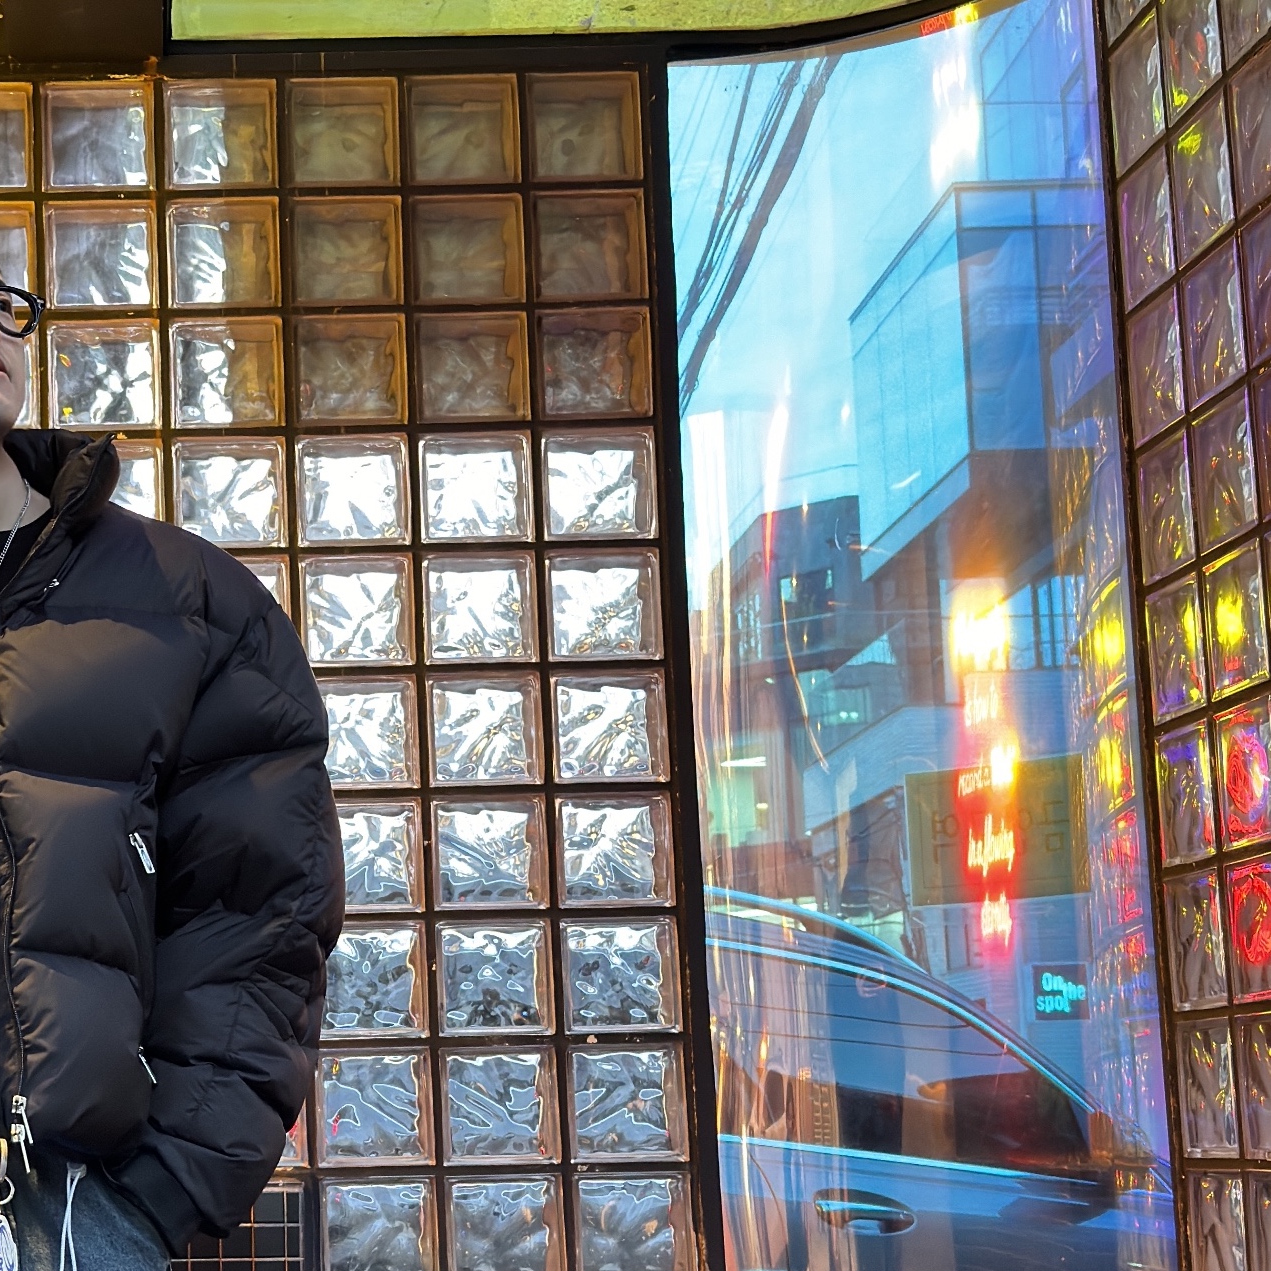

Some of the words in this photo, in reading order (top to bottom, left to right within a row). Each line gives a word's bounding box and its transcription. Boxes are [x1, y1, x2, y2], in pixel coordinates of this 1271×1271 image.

[1042, 972, 1064, 991] On
[1062, 982, 1086, 1000] the
[1036, 995, 1070, 1013] spot
